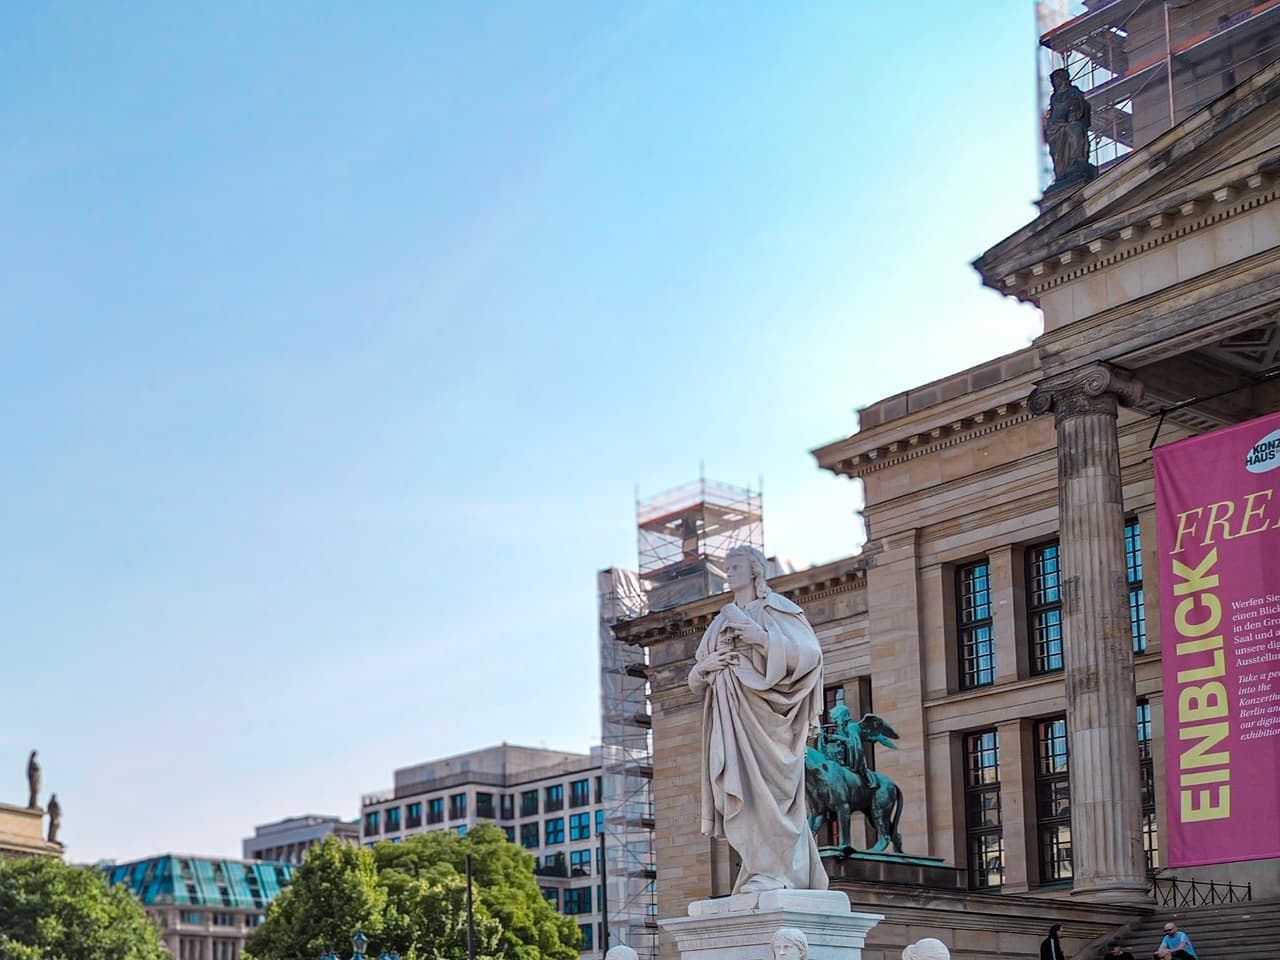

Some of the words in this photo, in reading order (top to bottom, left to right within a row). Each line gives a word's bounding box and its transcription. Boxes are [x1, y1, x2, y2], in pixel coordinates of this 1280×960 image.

[1246, 450, 1275, 466] HAUS
[1169, 489, 1280, 554] FRE
[1232, 598, 1264, 609] Werfen
[1232, 611, 1257, 621] einen
[1233, 624, 1242, 633] in
[1244, 621, 1261, 630] den
[1234, 633, 1253, 644] Saal
[1255, 629, 1273, 640] und
[1235, 644, 1265, 655] unsere
[1238, 673, 1259, 683] Take
[1172, 546, 1230, 823] EINBLICK
[1238, 687, 1256, 695] into
[1258, 682, 1271, 691] the
[1240, 706, 1265, 717] Berlin
[1240, 721, 1255, 729] our
